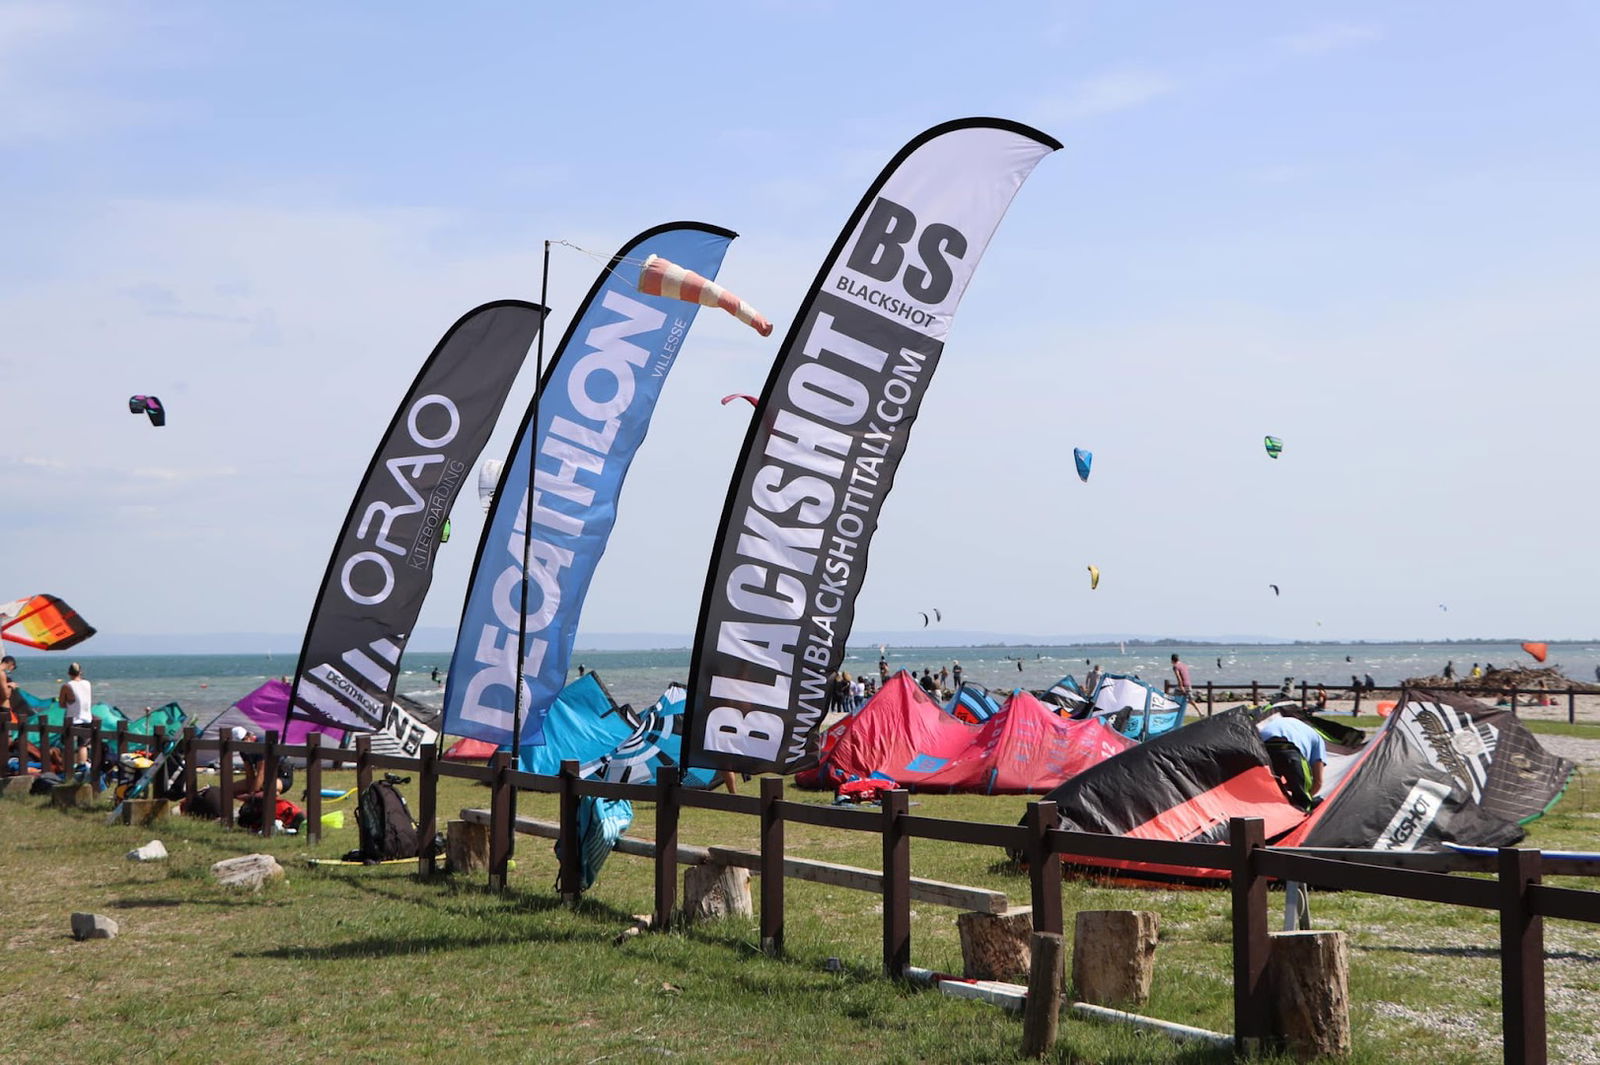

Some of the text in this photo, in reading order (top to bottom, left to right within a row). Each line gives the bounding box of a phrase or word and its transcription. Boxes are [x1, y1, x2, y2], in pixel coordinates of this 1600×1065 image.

[836, 275, 936, 328] BLACKSHOT
[846, 197, 968, 304] BS
[651, 317, 688, 379] VILLESSE
[340, 393, 461, 605] ORAO
[408, 460, 466, 571] KITEBOARDING
[460, 290, 668, 732] DECATHLON
[704, 311, 889, 763] BLACKSHOT
[784, 347, 927, 764] WWW.BLACKSHOTITALY.COM
[325, 670, 380, 716] DECATHLON
